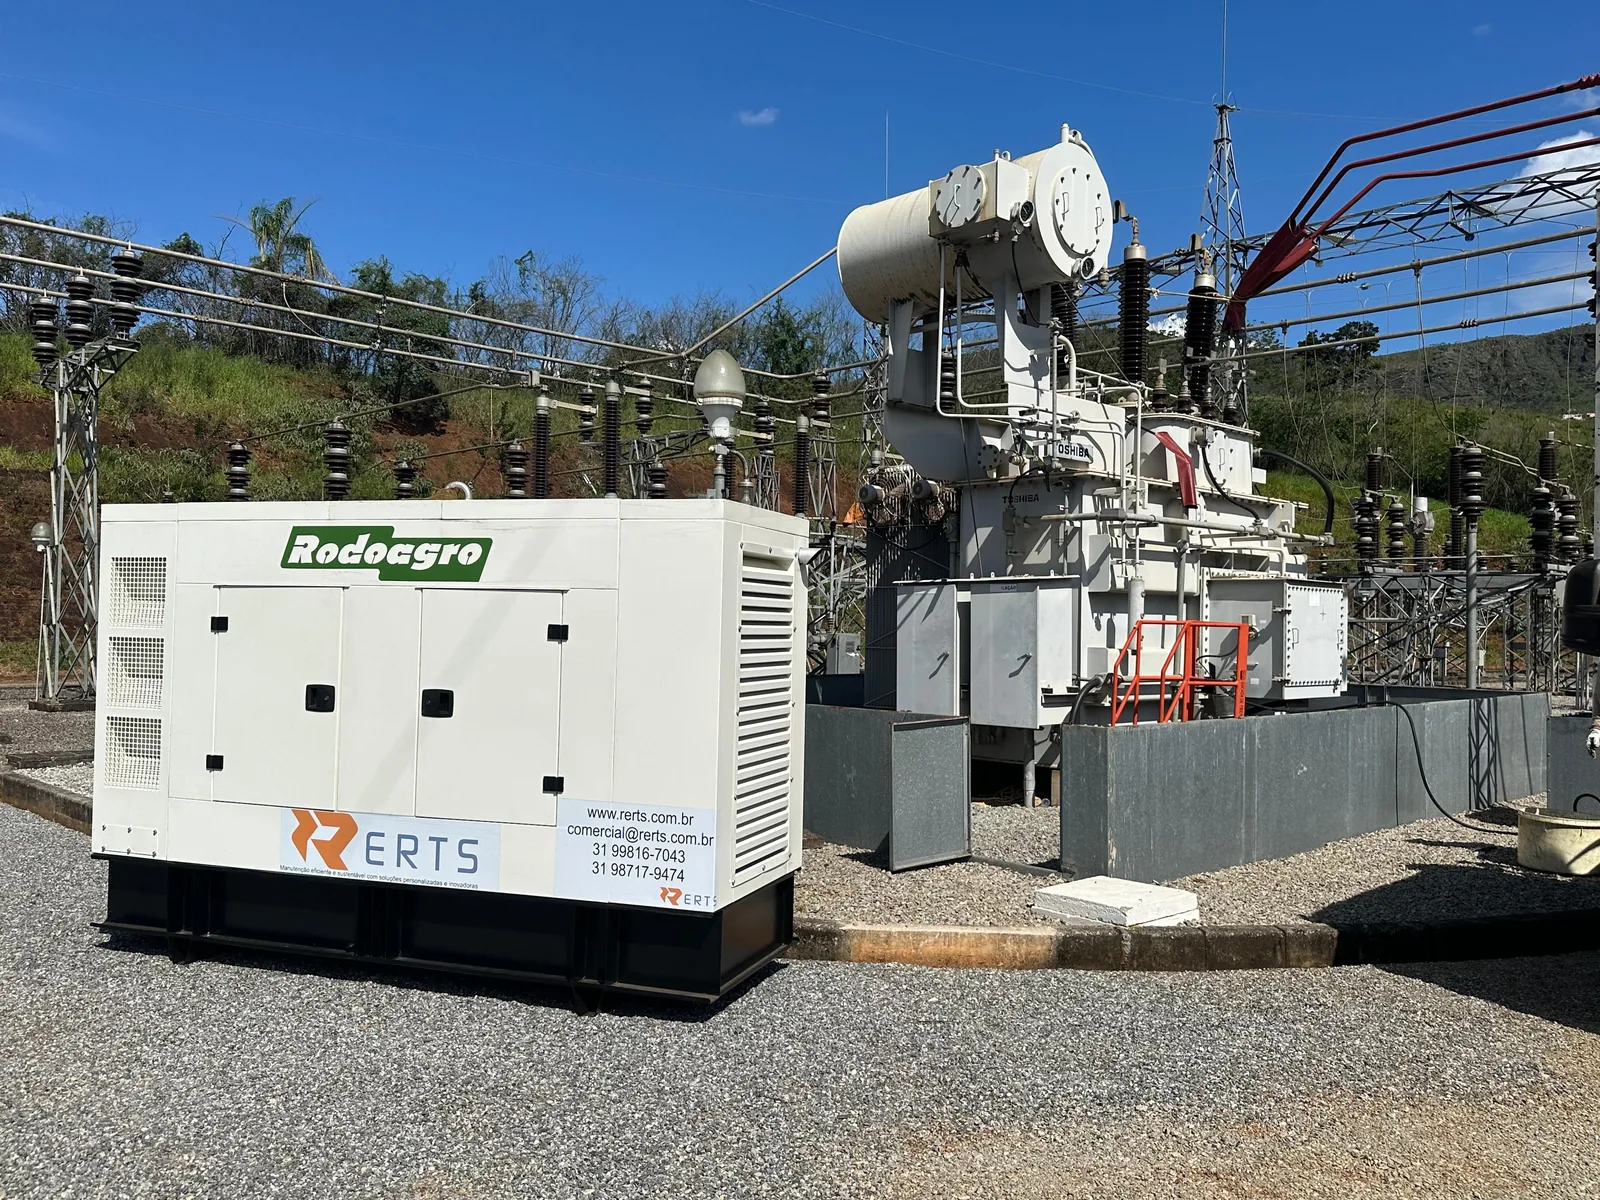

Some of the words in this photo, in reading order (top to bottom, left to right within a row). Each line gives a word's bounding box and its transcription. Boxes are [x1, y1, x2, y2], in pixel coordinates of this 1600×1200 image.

[1056, 443, 1090, 458] OSHIBA
[1002, 494, 1039, 504] TOSHIBA
[287, 533, 482, 571] Rodoagro
[587, 808, 694, 825] www.rerts.com.br
[567, 824, 714, 847] comercial@rerts.com.br
[592, 842, 606, 856] 31
[611, 844, 686, 863] 99816-7043
[279, 864, 310, 874] Manutenção
[337, 869, 366, 879] sustentável
[379, 874, 402, 883] soluções
[403, 877, 443, 887] personalizadas
[449, 880, 479, 890] inovadoras
[592, 861, 606, 875] 31
[611, 863, 685, 882] 98717-9474
